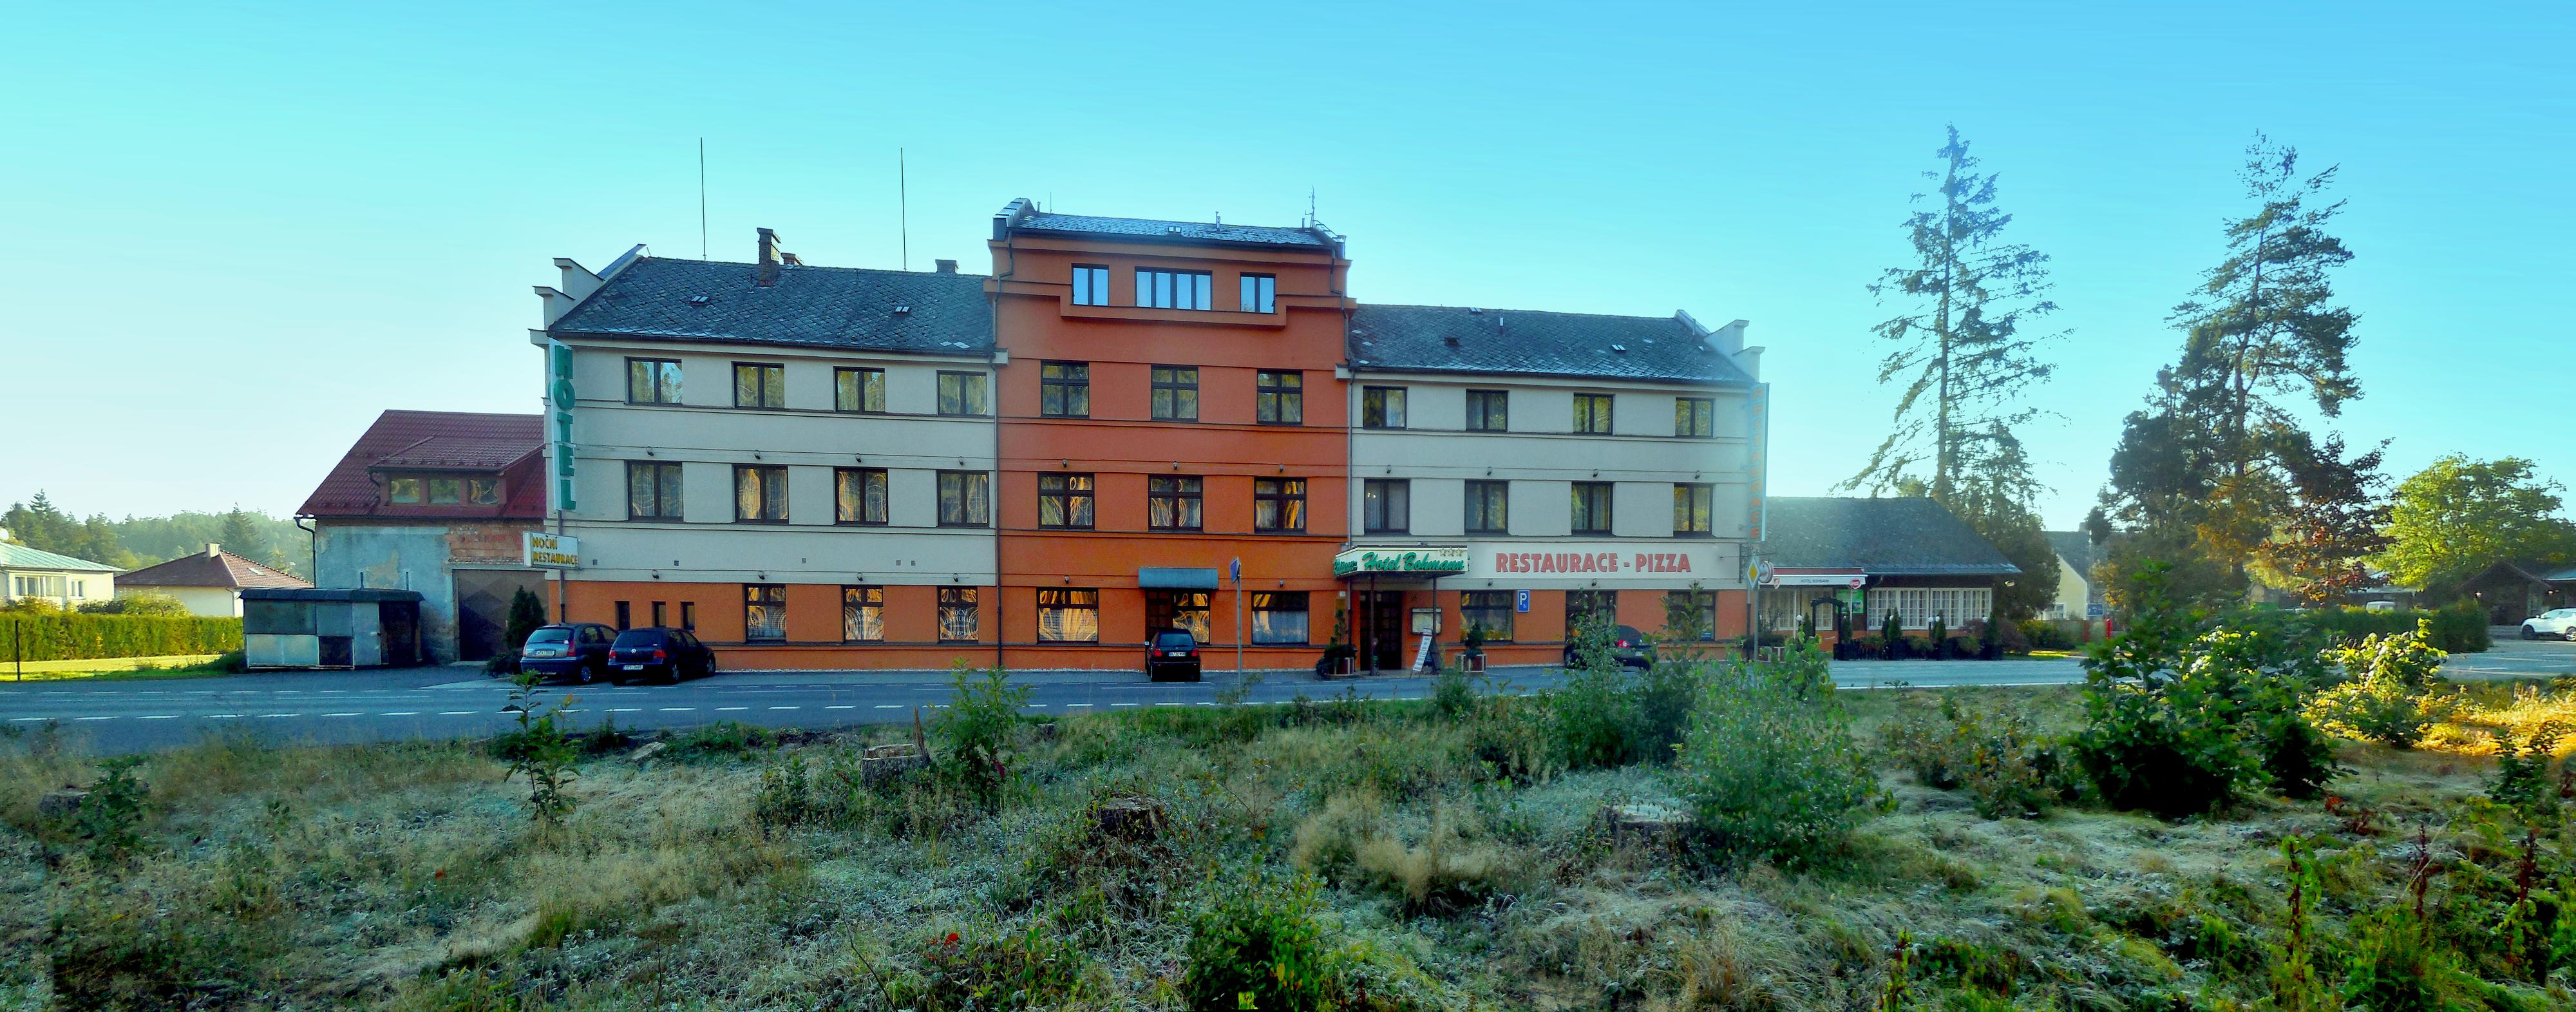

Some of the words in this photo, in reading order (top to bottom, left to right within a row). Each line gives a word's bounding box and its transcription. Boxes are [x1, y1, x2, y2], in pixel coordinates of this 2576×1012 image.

[554, 345, 576, 510] HOTEL
[1750, 388, 1764, 539] RESTAURACE
[533, 535, 558, 549] NOČNÍ
[533, 551, 578, 565] RESTAURACE
[1361, 551, 1401, 571] Hotel
[1403, 551, 1465, 571] Bohmann
[1495, 553, 1618, 573] RESTAURACE
[1635, 553, 1691, 573] PIZZA
[1520, 592, 1527, 606] P
